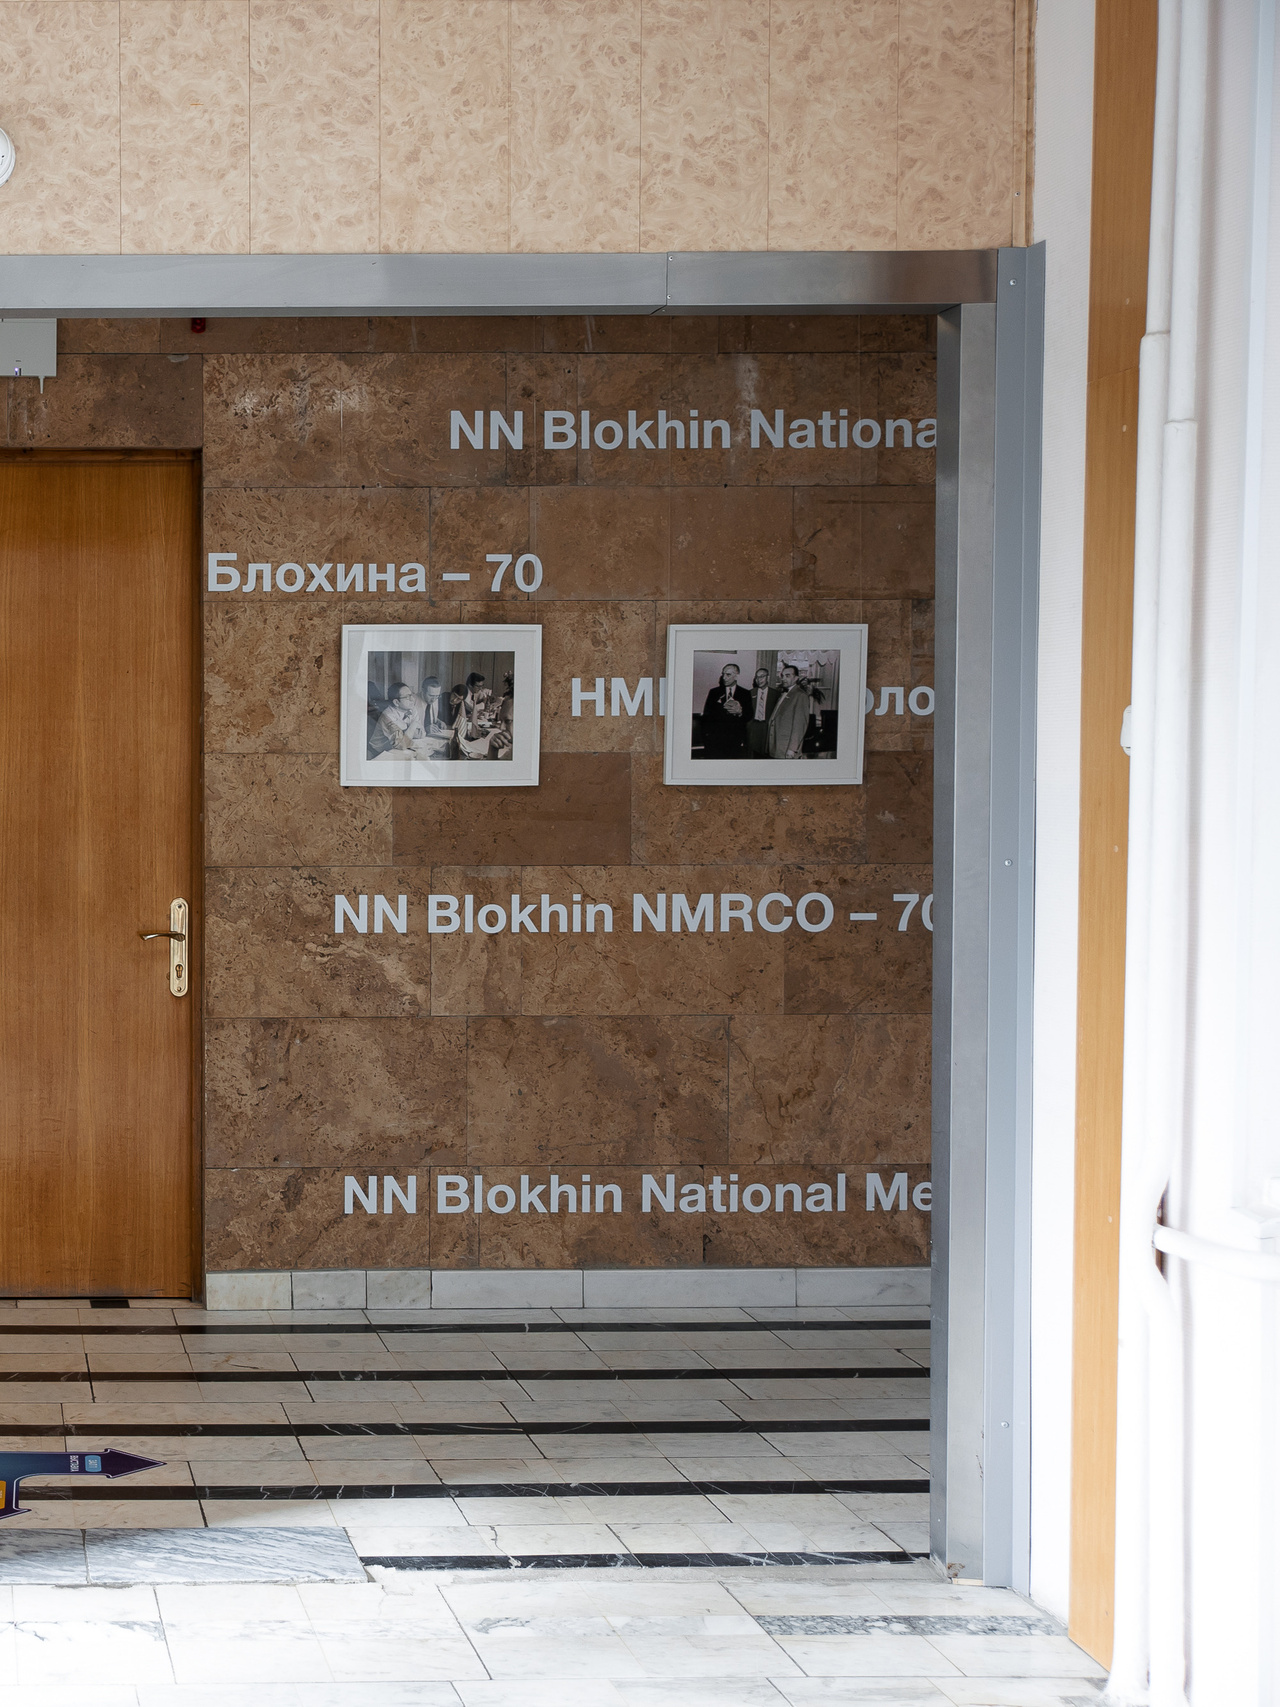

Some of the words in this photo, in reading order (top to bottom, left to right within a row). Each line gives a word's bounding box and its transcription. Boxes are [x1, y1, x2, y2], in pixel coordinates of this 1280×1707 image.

[450, 410, 524, 450] NN
[543, 408, 732, 450] Blokhin
[750, 408, 937, 450] Nationa
[207, 551, 427, 594] Блохина
[485, 553, 544, 594] 70
[570, 676, 666, 718] НМ
[865, 685, 935, 717] ло
[333, 893, 408, 935] NN
[427, 893, 614, 934] Blokhin
[632, 891, 835, 933] NMRCO
[343, 1174, 418, 1215] NN
[436, 1174, 623, 1215] Blokhin
[641, 1172, 847, 1214] National
[865, 1171, 932, 1212] Me
